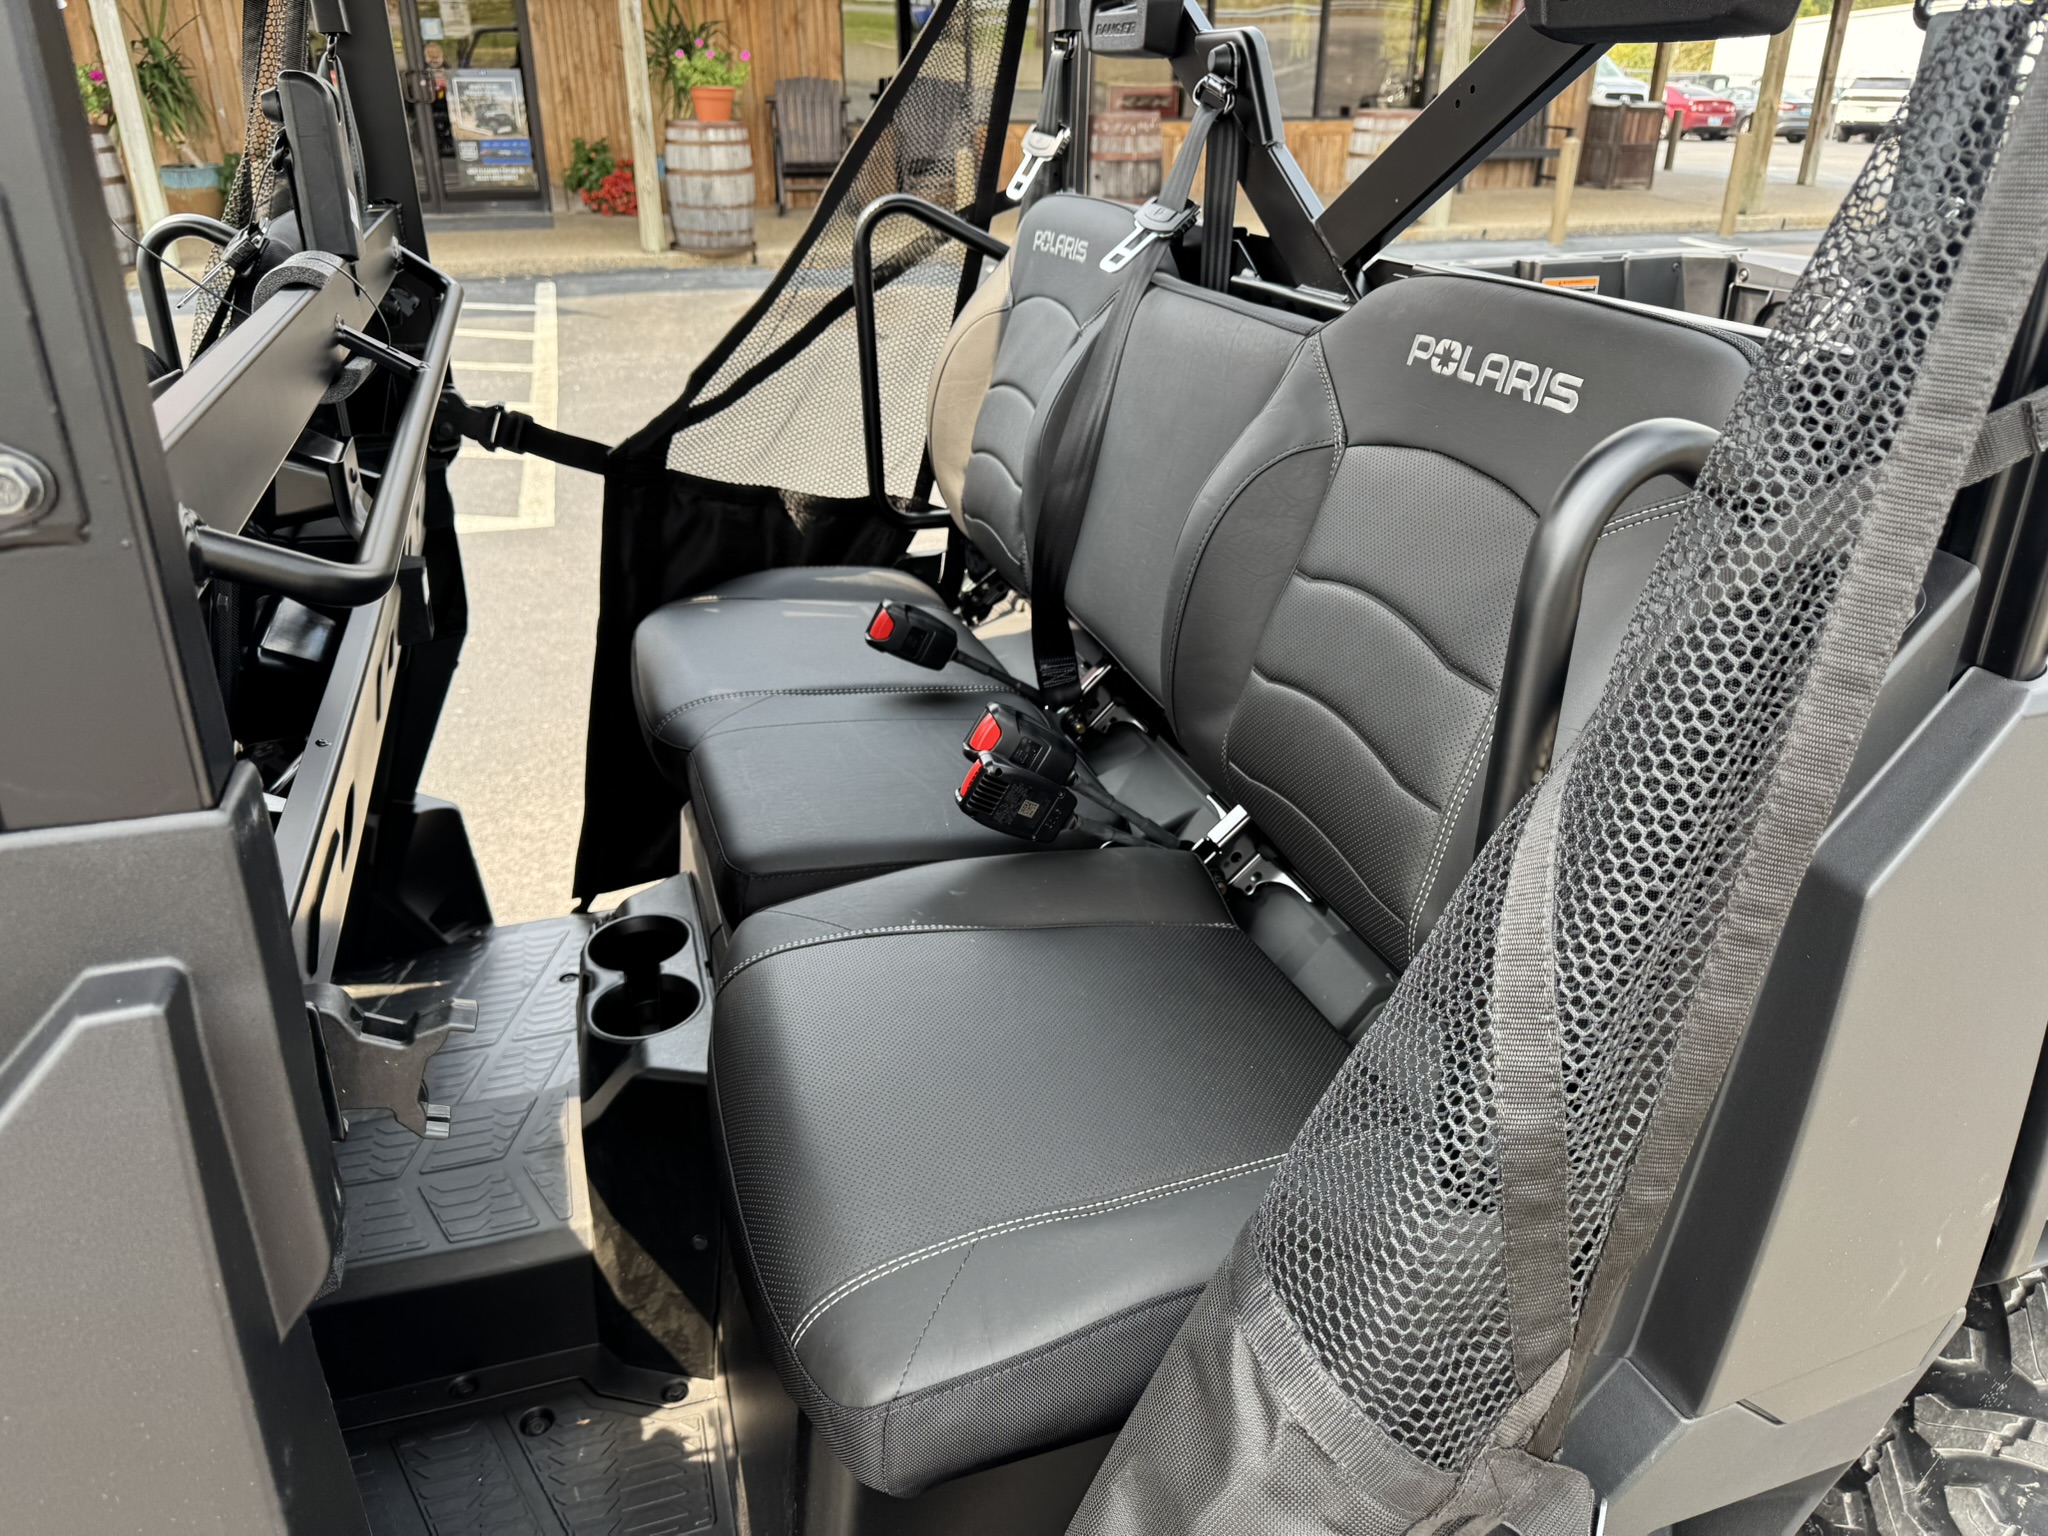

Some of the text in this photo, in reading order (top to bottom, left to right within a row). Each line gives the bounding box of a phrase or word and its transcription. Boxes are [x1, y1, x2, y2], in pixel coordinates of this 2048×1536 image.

[1095, 21, 1137, 36] RANGER
[1032, 230, 1088, 263] POLARIS
[1406, 333, 1585, 414] POLARIS
